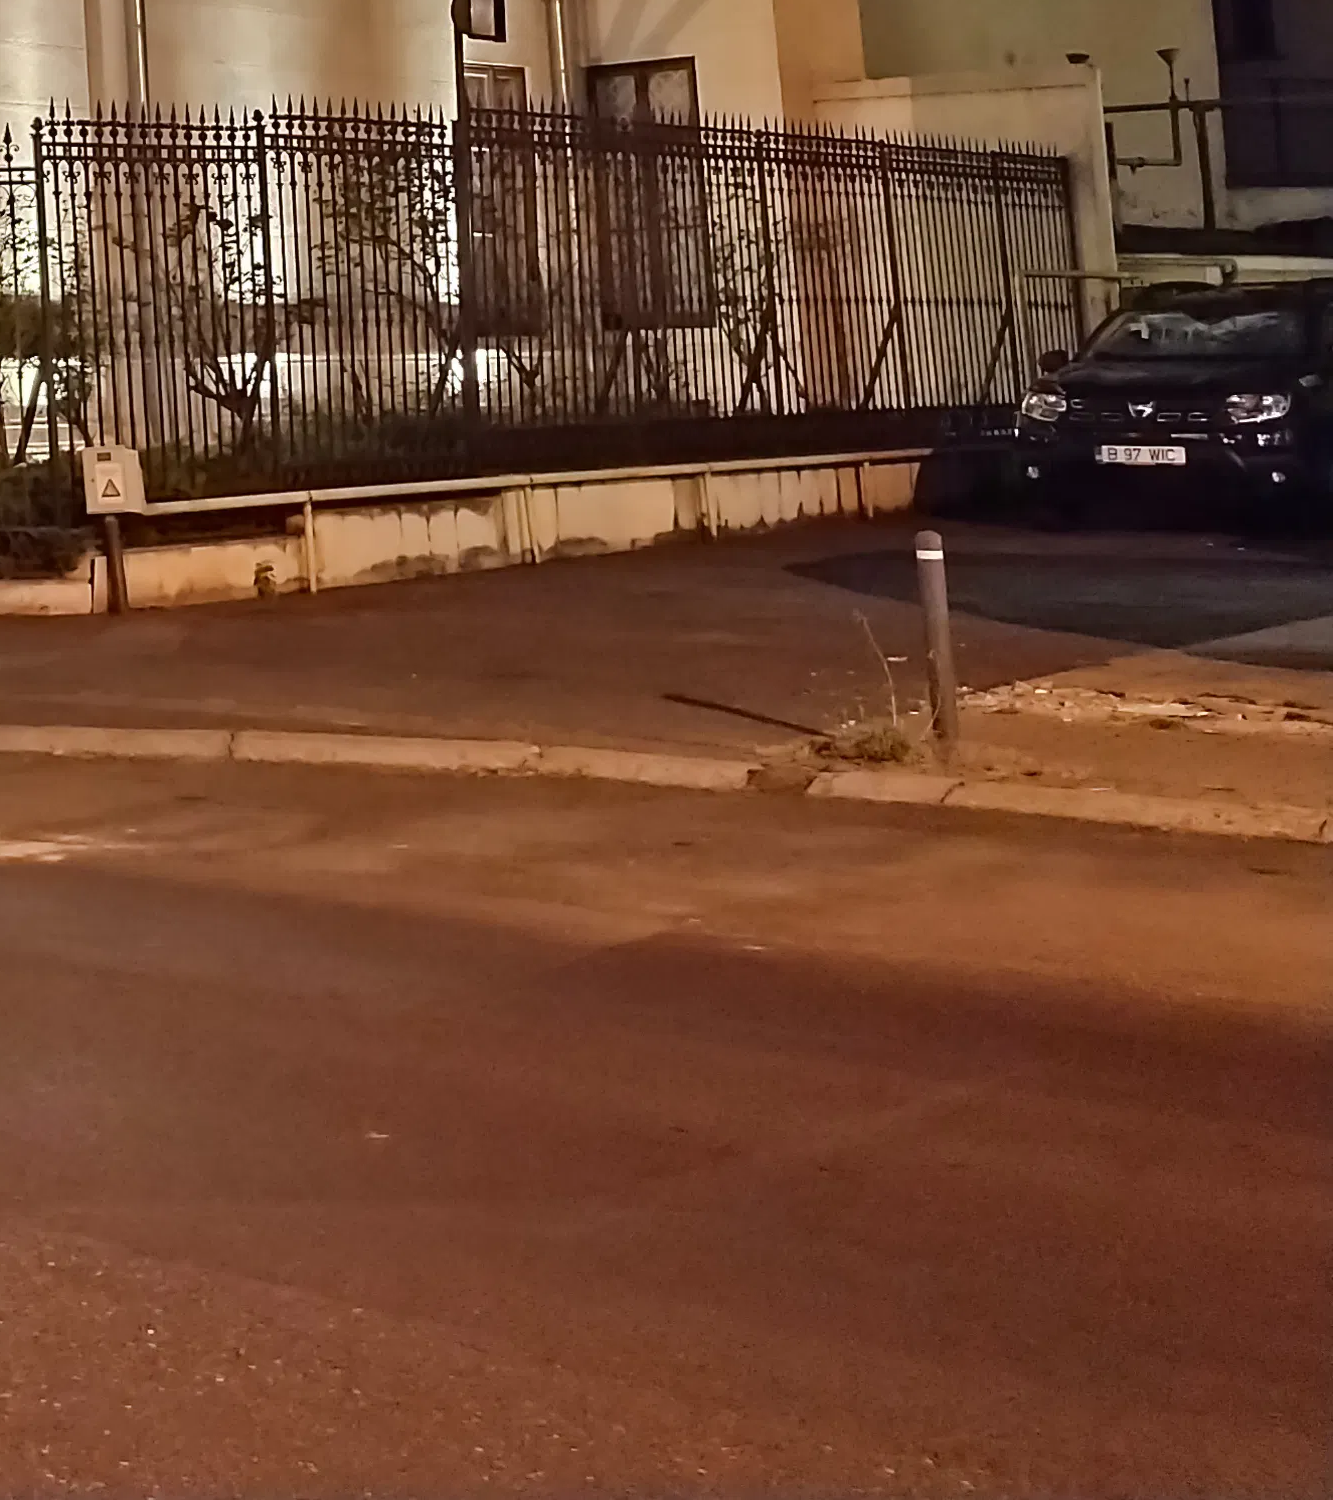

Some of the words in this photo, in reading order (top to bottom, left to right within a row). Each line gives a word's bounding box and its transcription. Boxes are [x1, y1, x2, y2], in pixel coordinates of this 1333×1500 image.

[1106, 446, 1118, 461] B
[1123, 446, 1142, 461] 97
[1148, 447, 1176, 461] WIC
